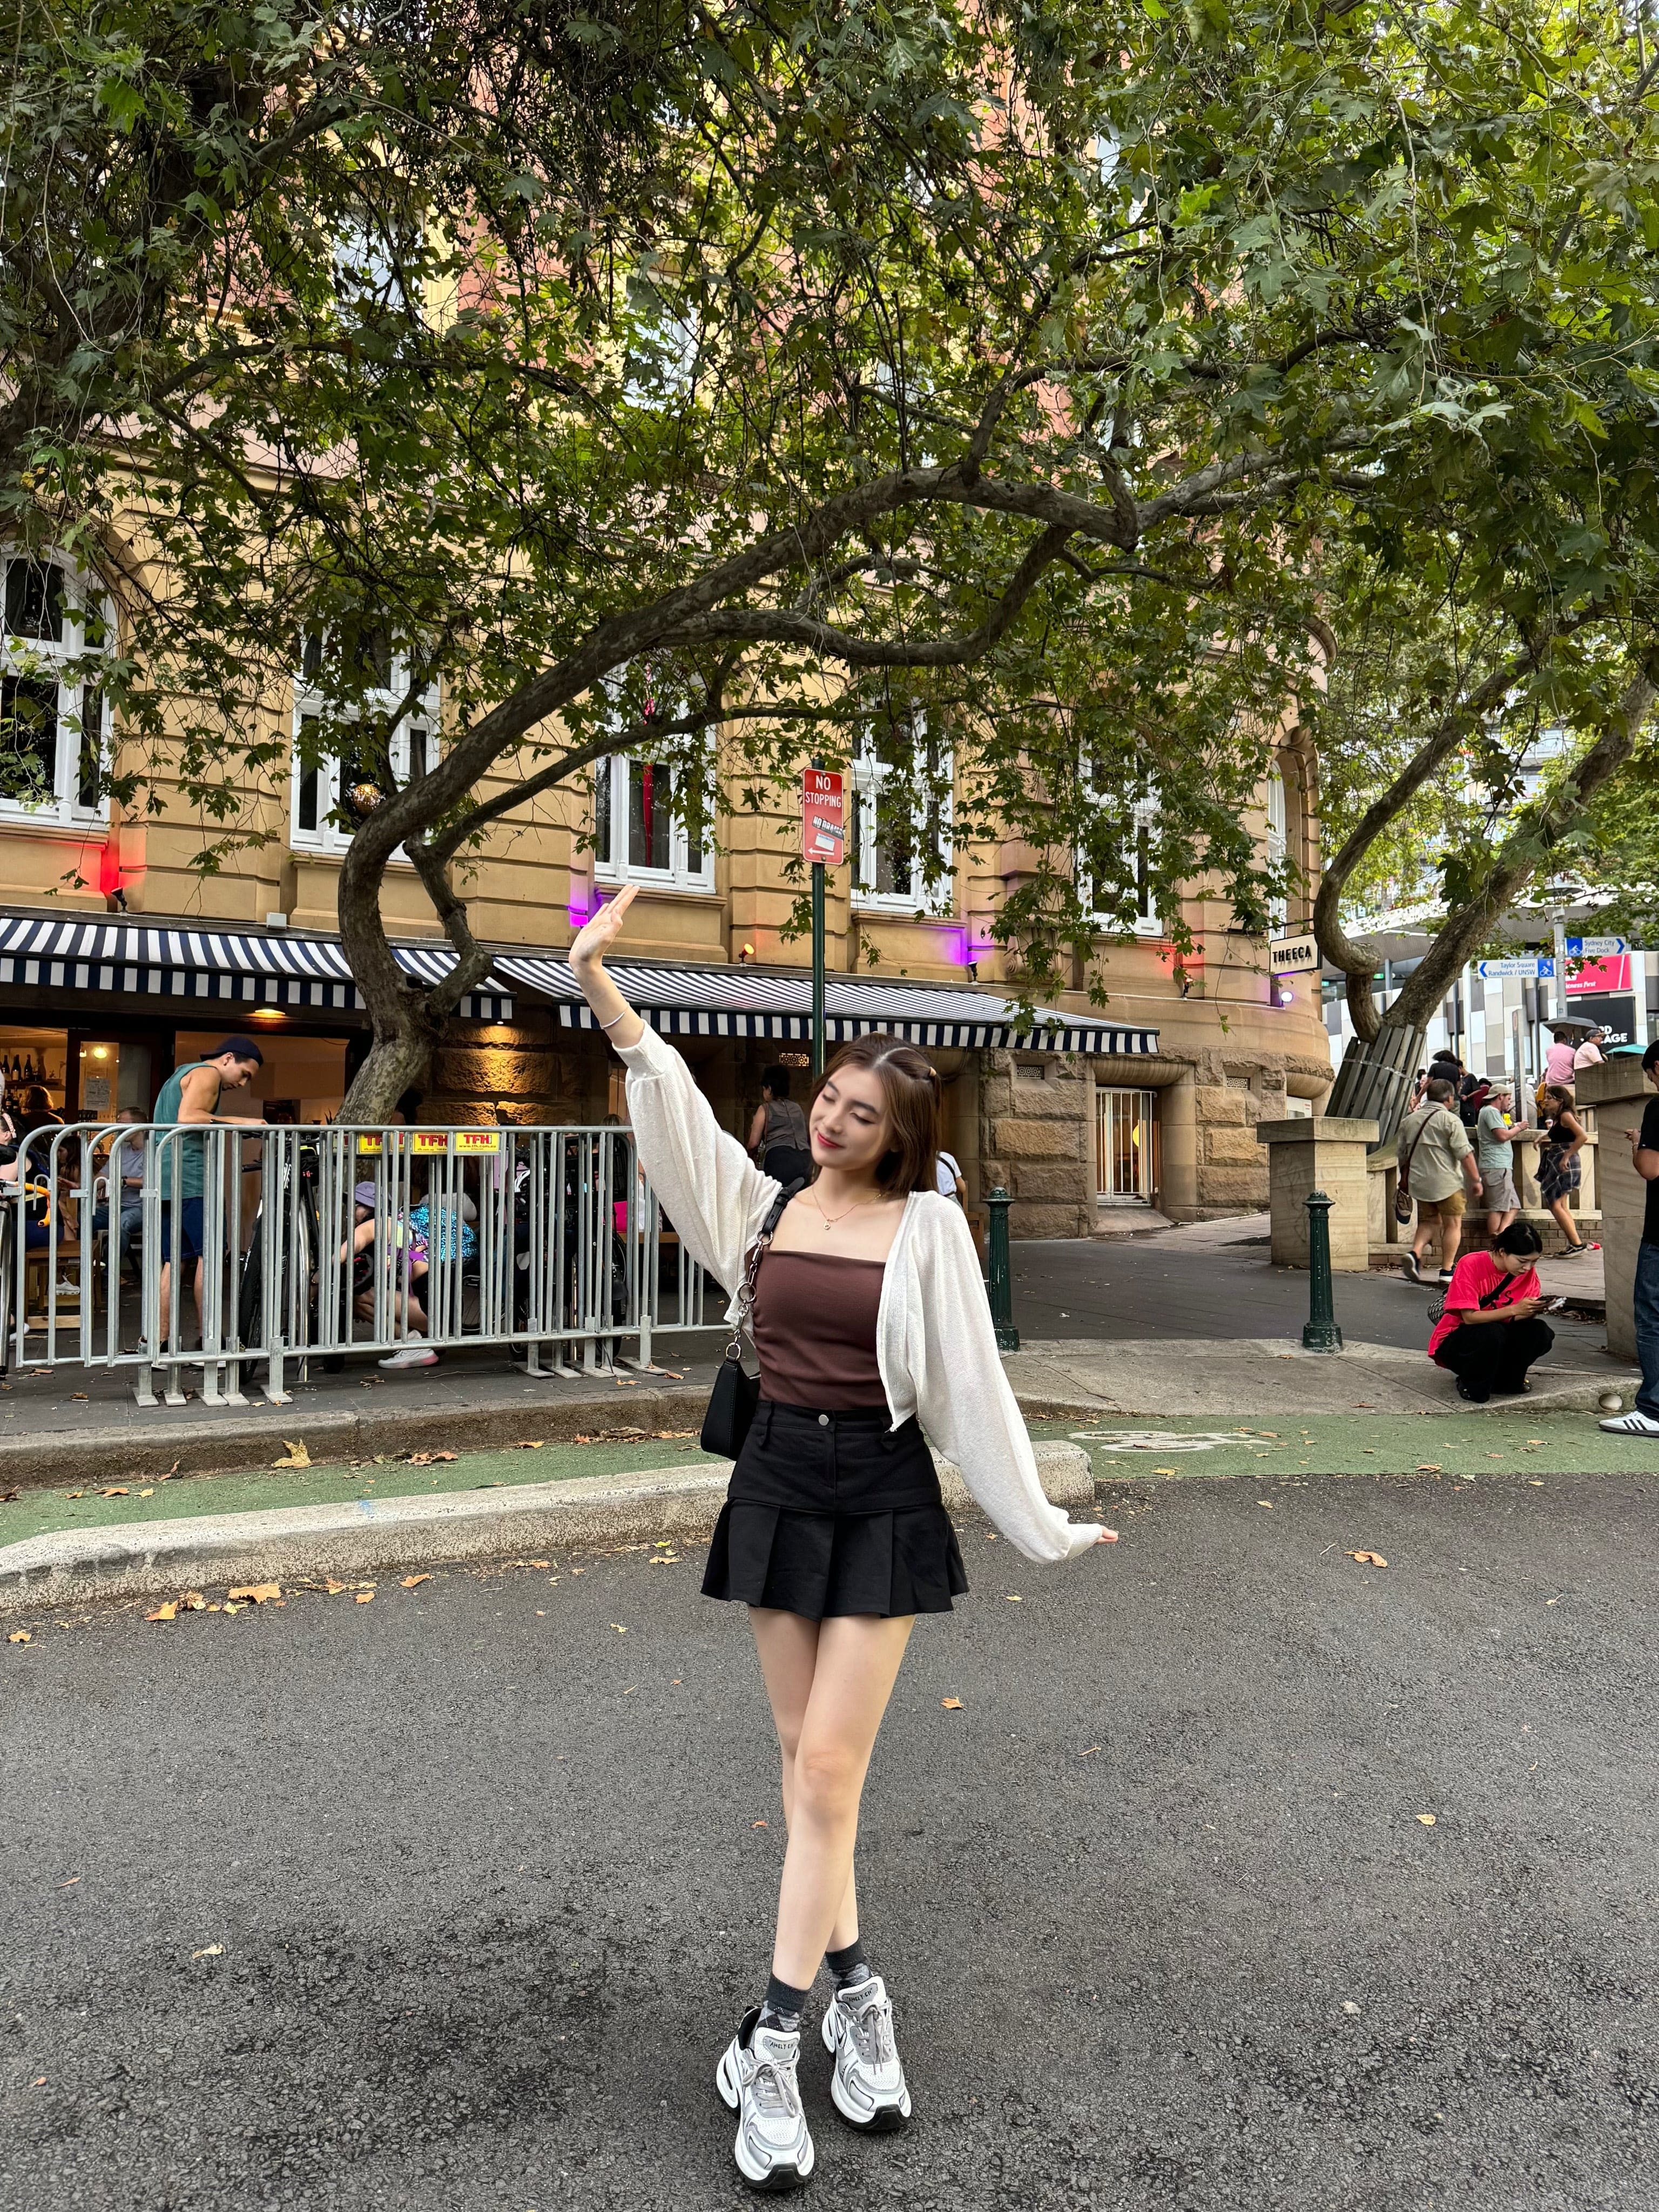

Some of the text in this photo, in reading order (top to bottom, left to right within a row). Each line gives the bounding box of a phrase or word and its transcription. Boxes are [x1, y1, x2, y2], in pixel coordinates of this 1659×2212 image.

[816, 775, 831, 790] NO
[805, 791, 841, 808] STOPPING
[1272, 945, 1312, 963] THEECA
[418, 1135, 448, 1147] TFH
[463, 1135, 490, 1144] TFH
